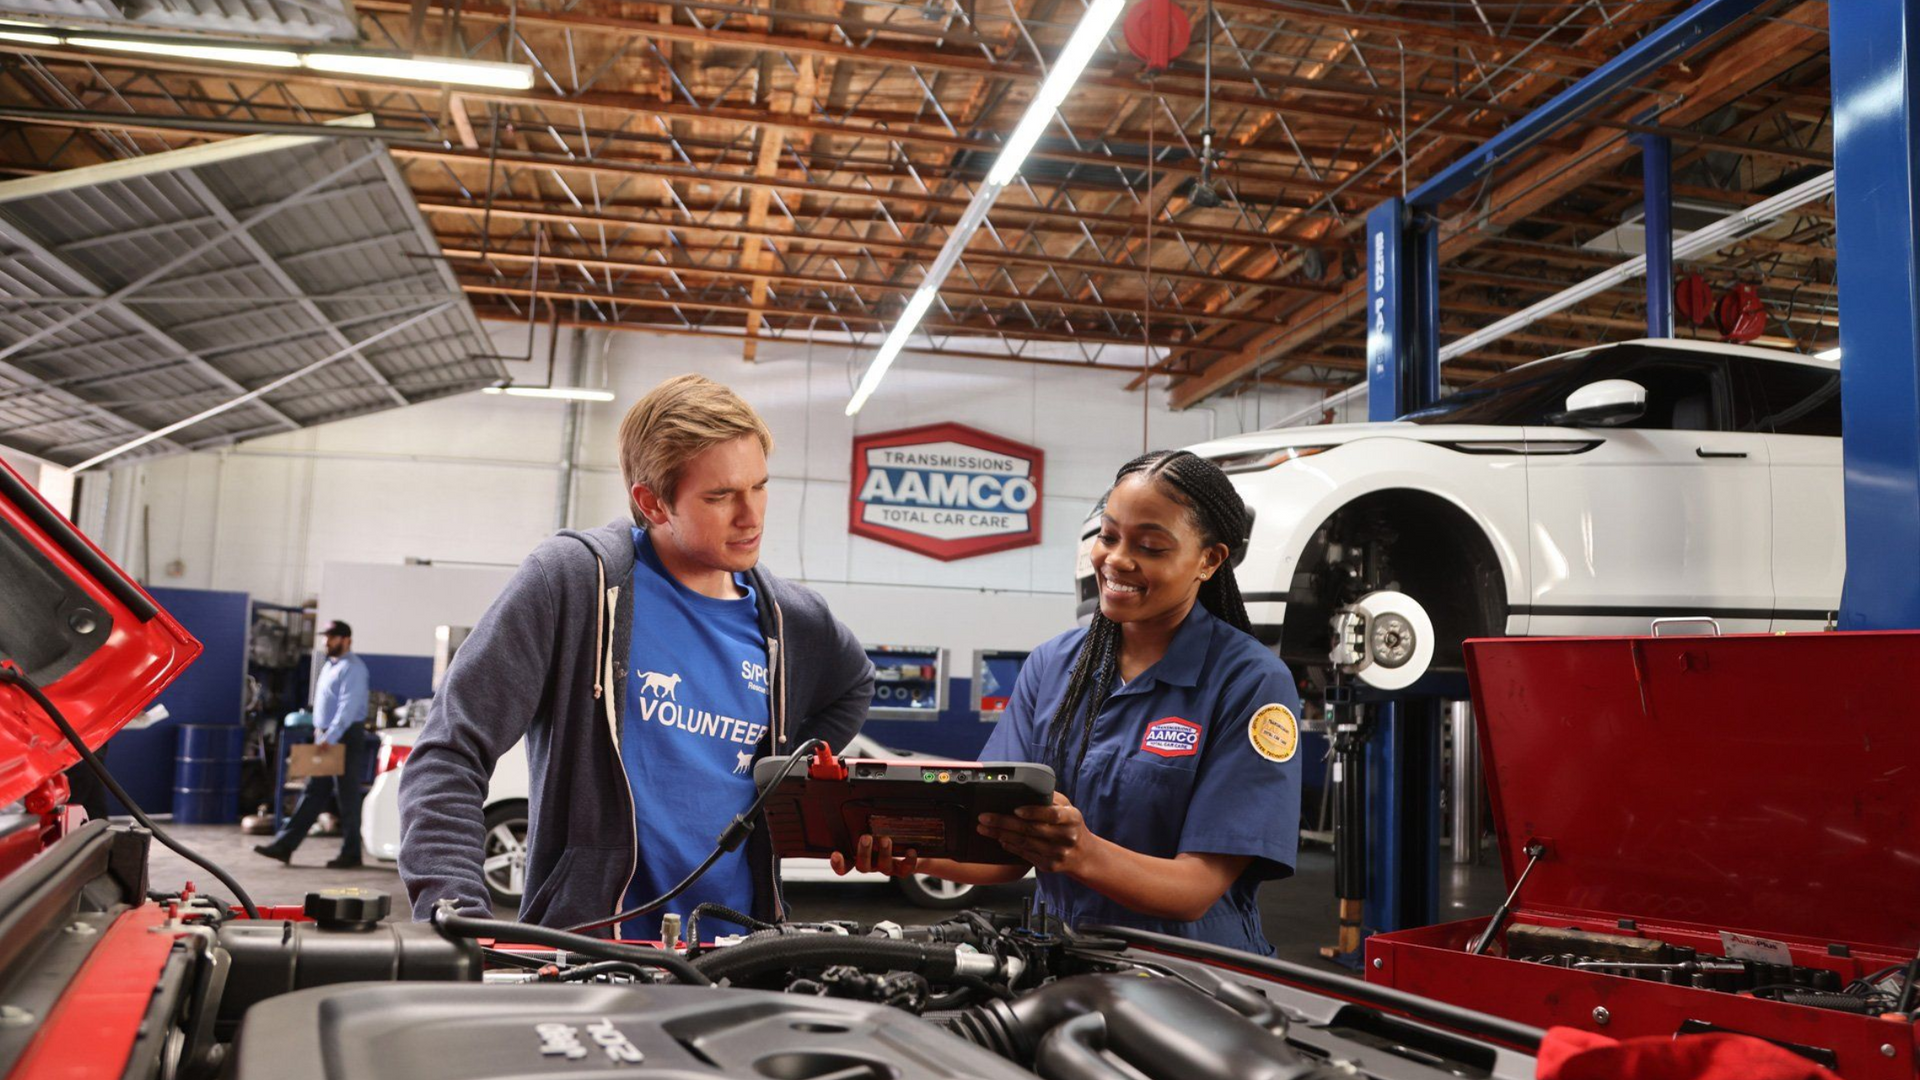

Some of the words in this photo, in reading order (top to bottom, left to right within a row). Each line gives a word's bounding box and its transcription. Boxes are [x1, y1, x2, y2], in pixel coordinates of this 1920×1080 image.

[1375, 231, 1385, 293] BEND
[884, 451, 1014, 471] TRANSMISSIONS
[858, 469, 1037, 511] AAMCO
[882, 509, 928, 524] TOTAL
[933, 512, 965, 526] CAR
[970, 515, 1010, 529] CARE
[1146, 730, 1198, 744] AAMCO
[1731, 935, 1778, 950] AutoPlus
